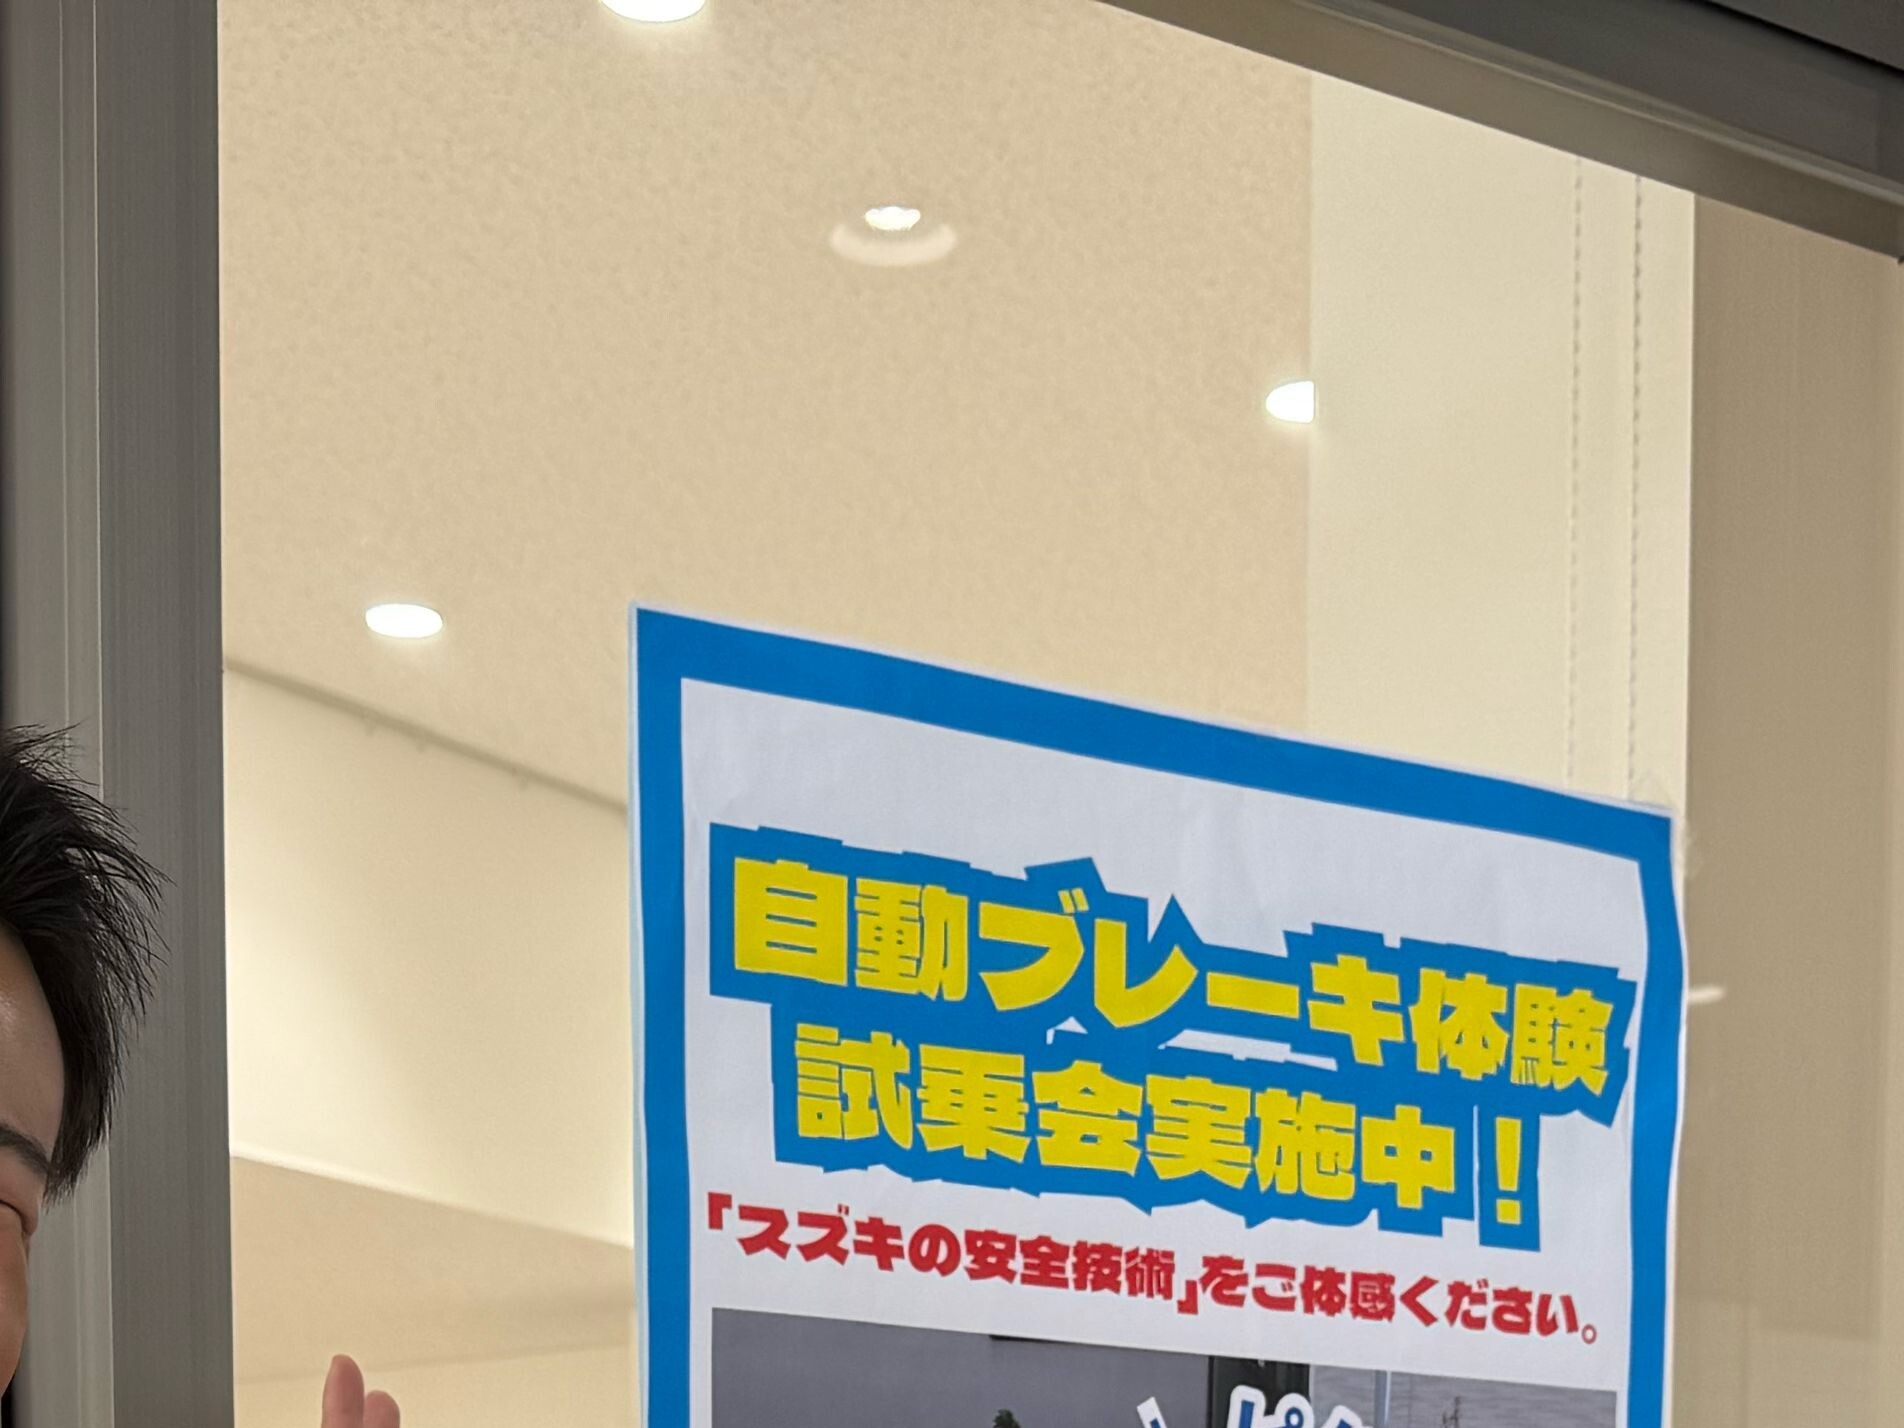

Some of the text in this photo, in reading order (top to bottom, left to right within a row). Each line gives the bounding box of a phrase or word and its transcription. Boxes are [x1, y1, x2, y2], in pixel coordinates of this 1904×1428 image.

[733, 858, 1612, 1093] 自動ブレーキ体験
[795, 1023, 1522, 1224] 試乗会実施中！
[707, 1191, 1598, 1344] 「スズキの安全技術」をご体感ください。
